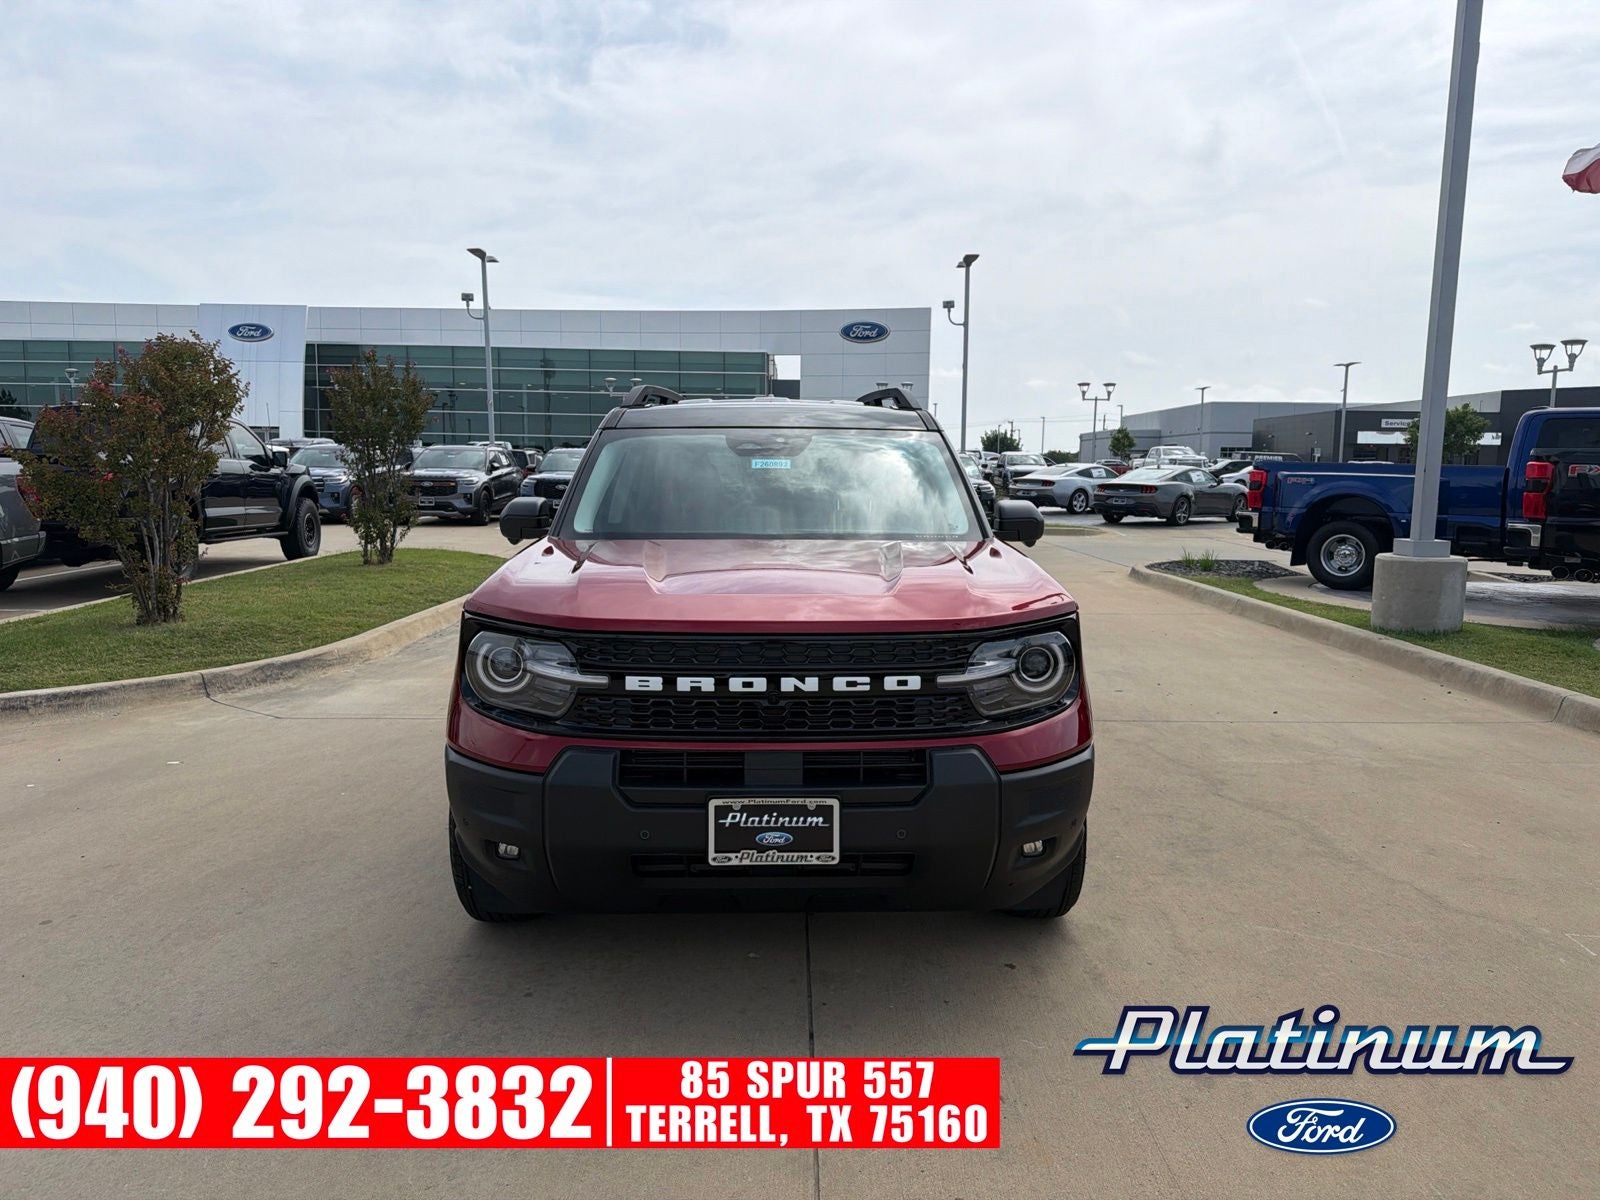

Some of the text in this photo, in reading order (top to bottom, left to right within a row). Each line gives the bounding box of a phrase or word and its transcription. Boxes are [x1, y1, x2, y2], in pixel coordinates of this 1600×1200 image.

[625, 675, 921, 692] BRONCO
[718, 812, 830, 827] Platinum
[738, 850, 813, 864] Platinum
